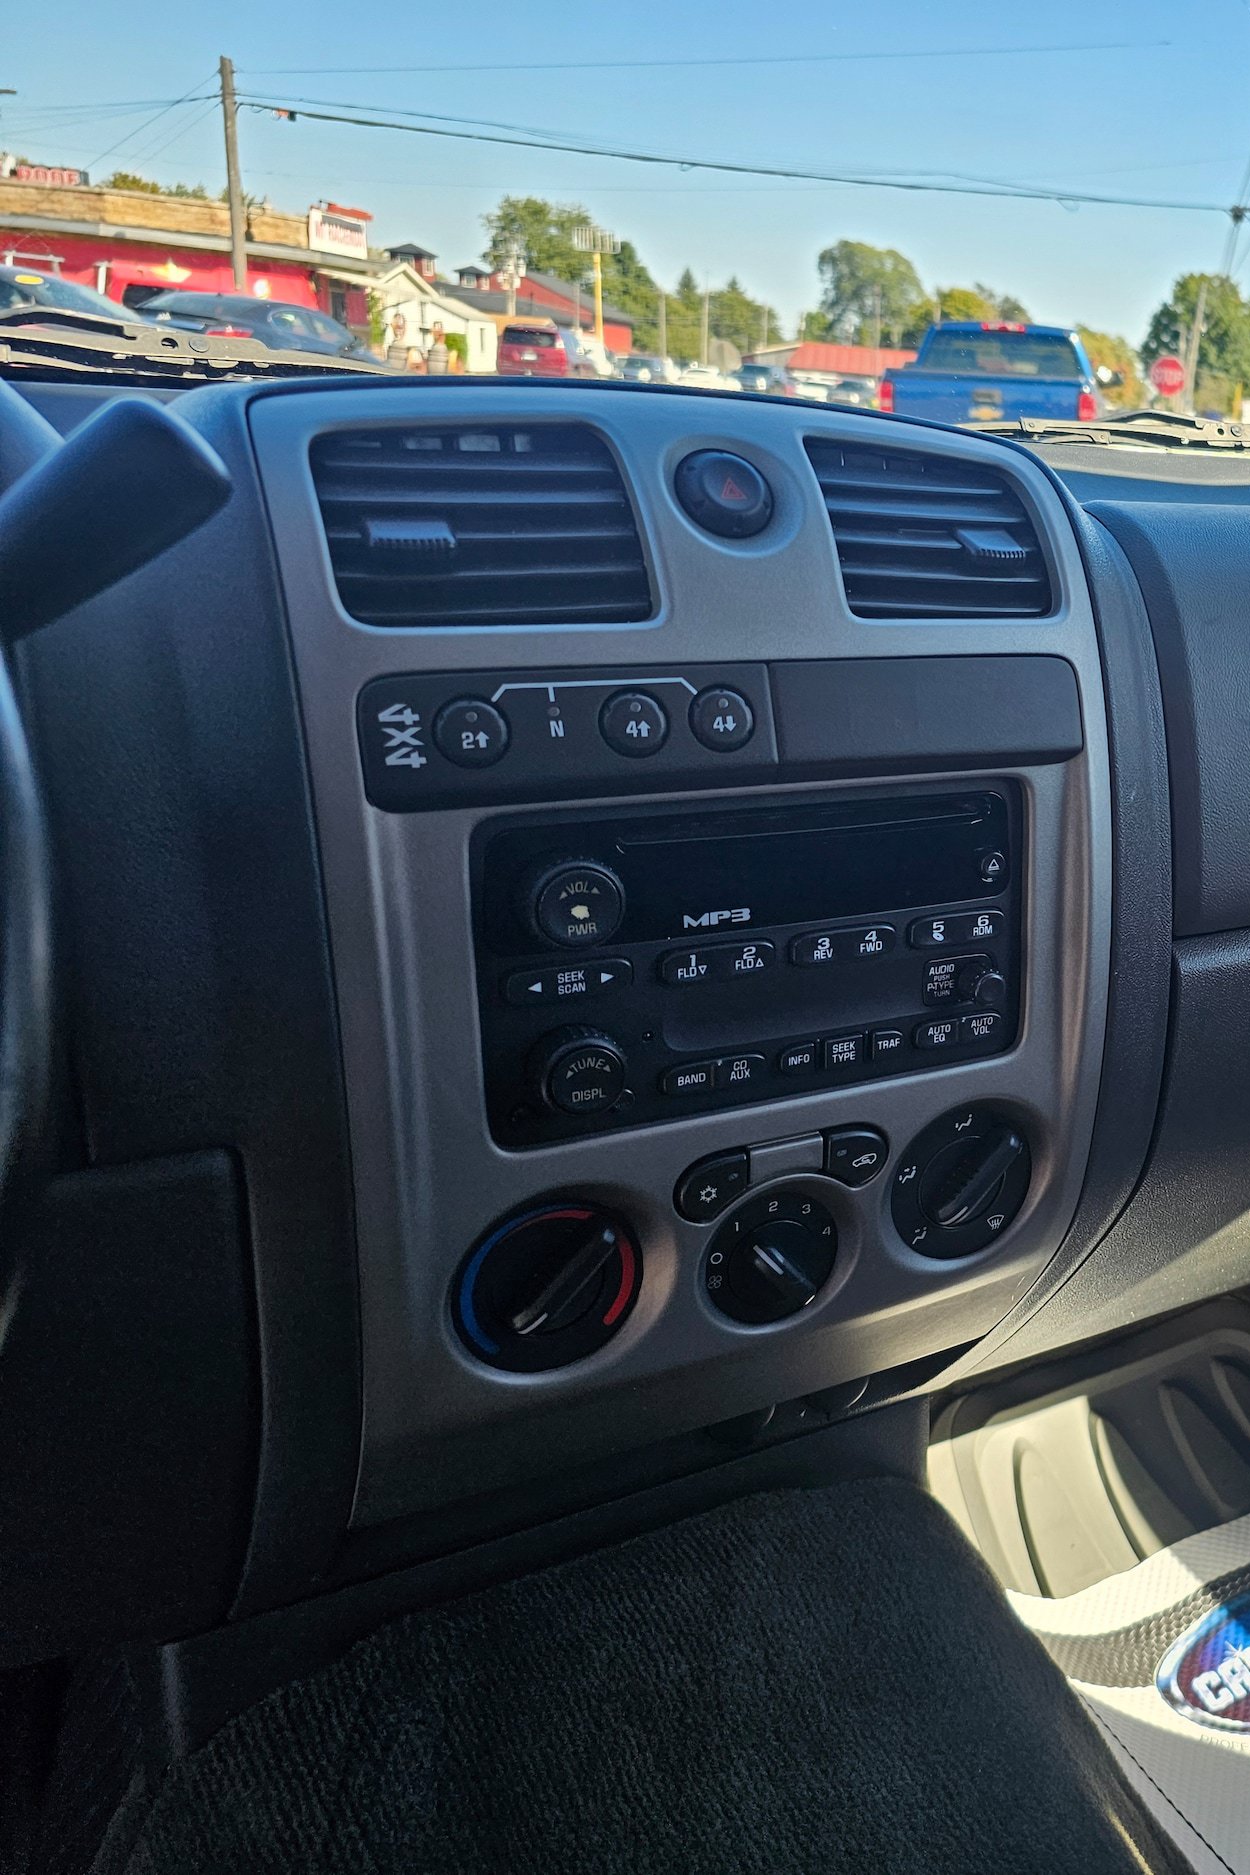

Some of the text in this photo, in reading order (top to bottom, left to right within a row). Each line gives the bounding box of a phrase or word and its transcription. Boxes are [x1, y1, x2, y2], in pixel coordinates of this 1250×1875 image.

[550, 720, 565, 738] N
[626, 720, 638, 737] 4
[713, 716, 725, 732] 4
[461, 733, 475, 749] 2
[566, 881, 590, 895] VOL
[683, 907, 751, 929] MP3
[977, 915, 990, 927] 6
[567, 922, 598, 936] PWR
[932, 921, 945, 933] 5
[973, 925, 993, 937] RDM
[864, 930, 878, 942] 4
[818, 937, 831, 950] 3
[860, 941, 883, 954] FWD
[743, 946, 757, 959] 2
[813, 948, 834, 961] REV
[689, 954, 696, 967] 1
[735, 958, 754, 971] FLD
[677, 966, 697, 979] FLD
[928, 963, 955, 976] AUDIO
[558, 970, 585, 984] SEEK
[933, 973, 950, 982] PUSH
[558, 982, 586, 995] SCAN
[933, 990, 951, 998] TURN
[971, 1017, 994, 1029] AUTO
[928, 1024, 951, 1036] AUTO
[973, 1025, 990, 1036] VOL
[877, 1038, 901, 1050] TRAF
[933, 1033, 946, 1044] EQ
[832, 1041, 856, 1053] SEEK
[788, 1054, 810, 1067] INFO
[832, 1051, 856, 1064] TYPE
[569, 1057, 606, 1073] TUNE
[733, 1060, 748, 1071] CD
[677, 1073, 706, 1087] BAND
[729, 1069, 750, 1081] AUX
[572, 1087, 607, 1103] DISPL
[768, 1200, 779, 1213] 2
[801, 1203, 811, 1215] 3
[734, 1221, 740, 1232] 1
[822, 1226, 831, 1236] 4
